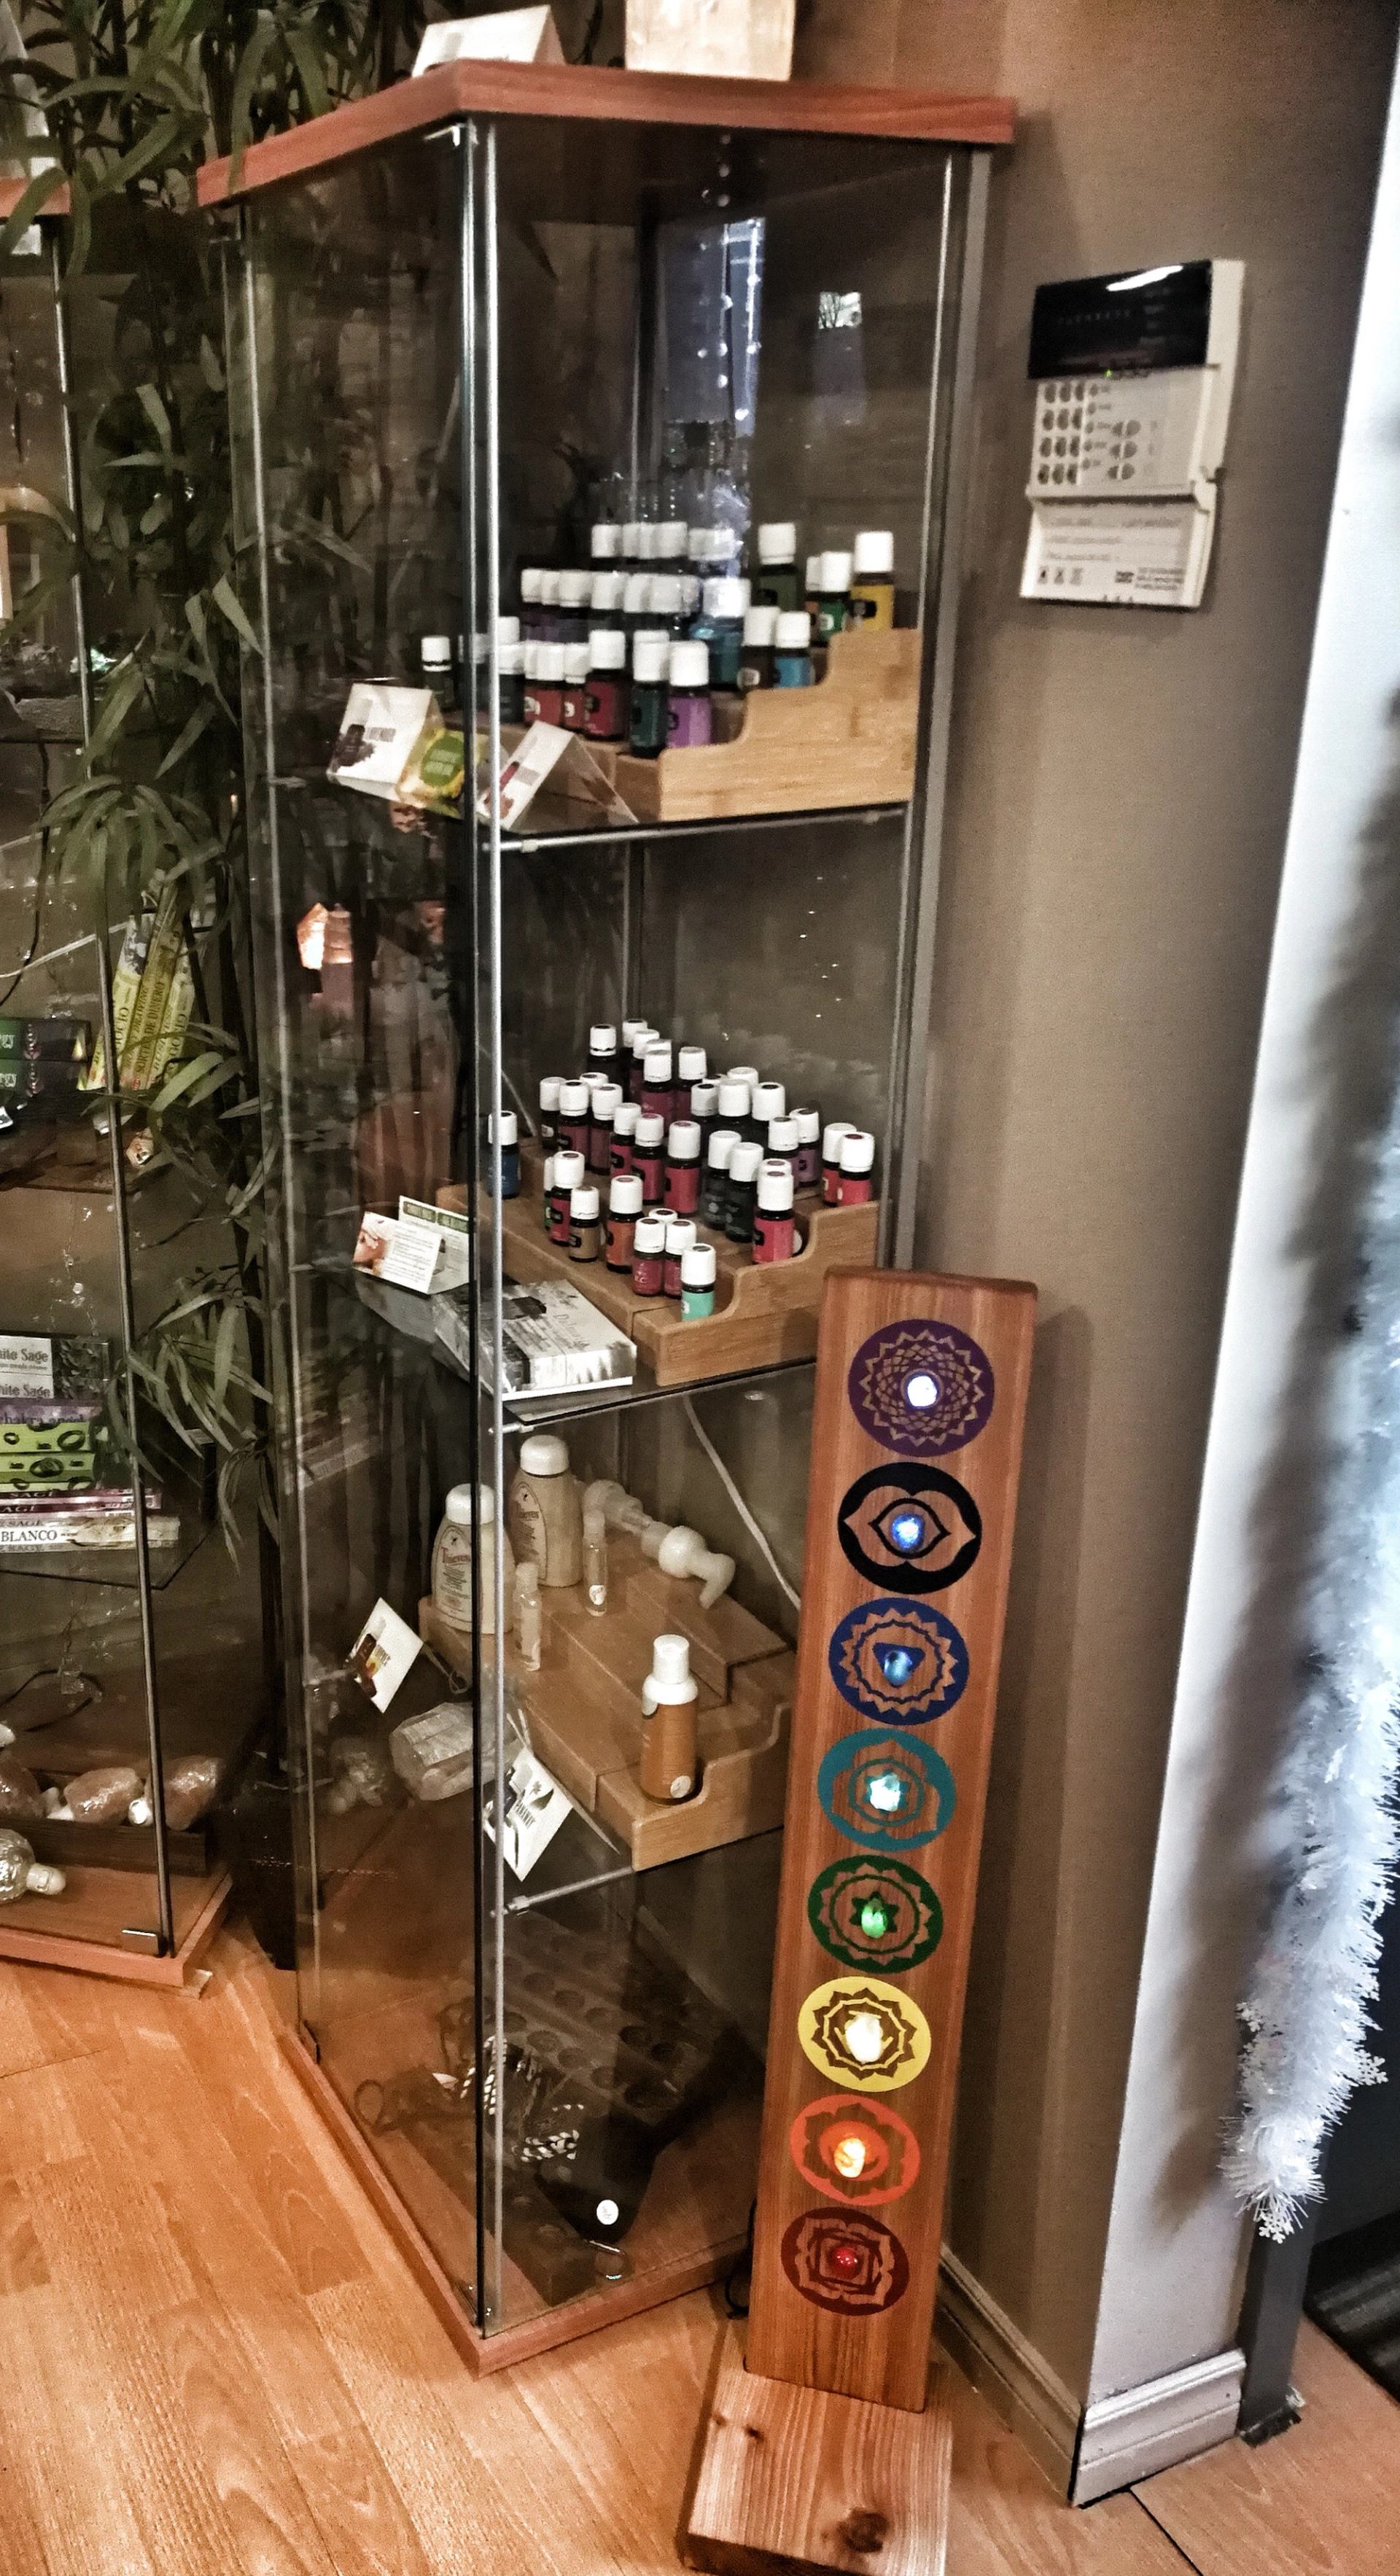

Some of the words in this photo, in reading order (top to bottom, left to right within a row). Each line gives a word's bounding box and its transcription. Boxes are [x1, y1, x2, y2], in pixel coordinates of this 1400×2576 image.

[21, 1348, 48, 1364] Sage
[23, 1384, 50, 1399] Sage
[1, 1530, 58, 1542] BLANCO
